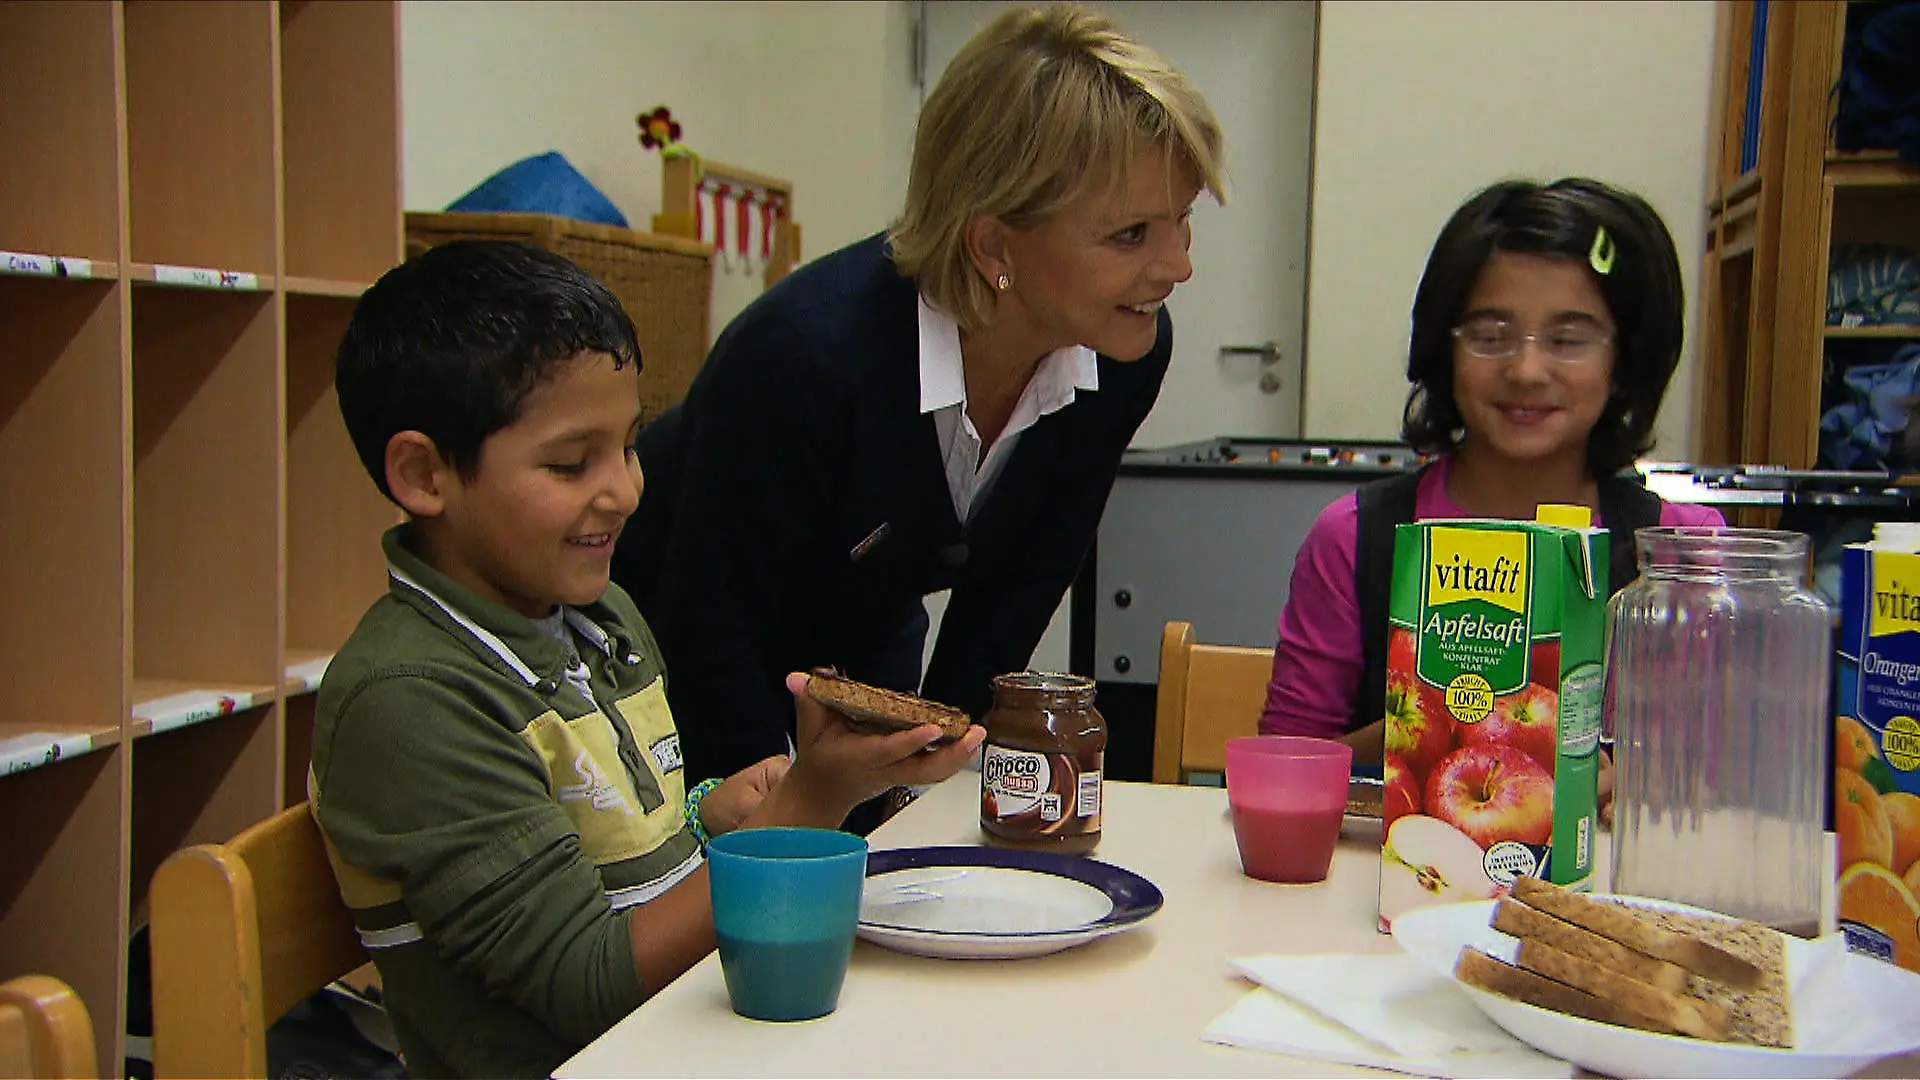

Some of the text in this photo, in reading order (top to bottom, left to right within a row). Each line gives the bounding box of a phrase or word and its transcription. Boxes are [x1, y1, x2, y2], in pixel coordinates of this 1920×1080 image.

[1435, 553, 1520, 594] vitafit
[1423, 612, 1525, 648] Apfelsaft
[1438, 641, 1456, 651] AUS
[1453, 689, 1488, 708] 100%
[1887, 734, 1919, 754] 100%
